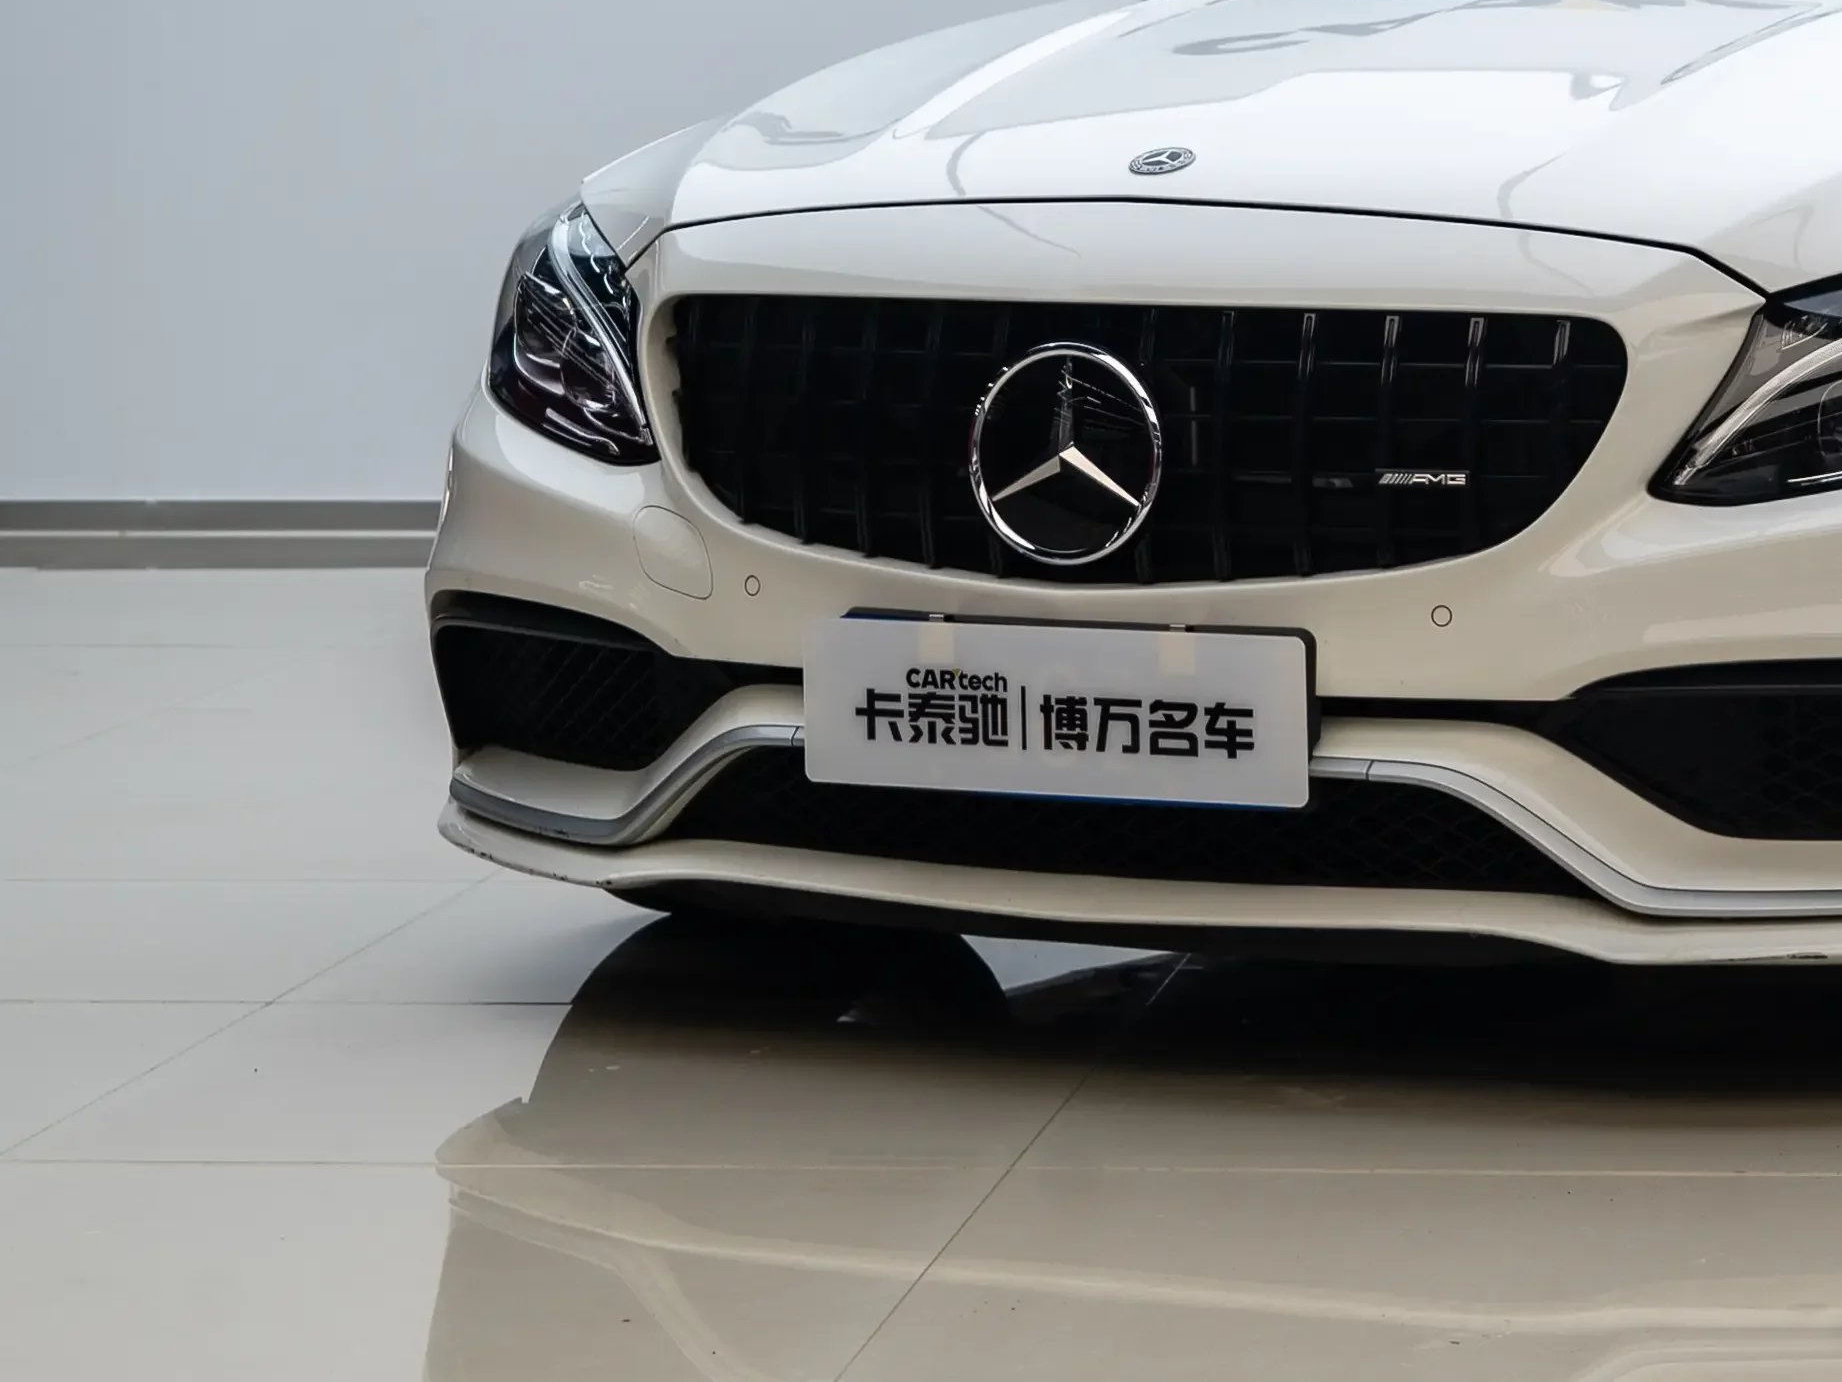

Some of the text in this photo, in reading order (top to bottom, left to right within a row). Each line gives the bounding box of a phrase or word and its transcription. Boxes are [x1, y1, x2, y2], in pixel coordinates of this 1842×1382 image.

[1407, 473, 1466, 485] AMG
[905, 667, 1008, 693] CARtech
[854, 687, 1255, 760] 卡泰驰 博万名车
